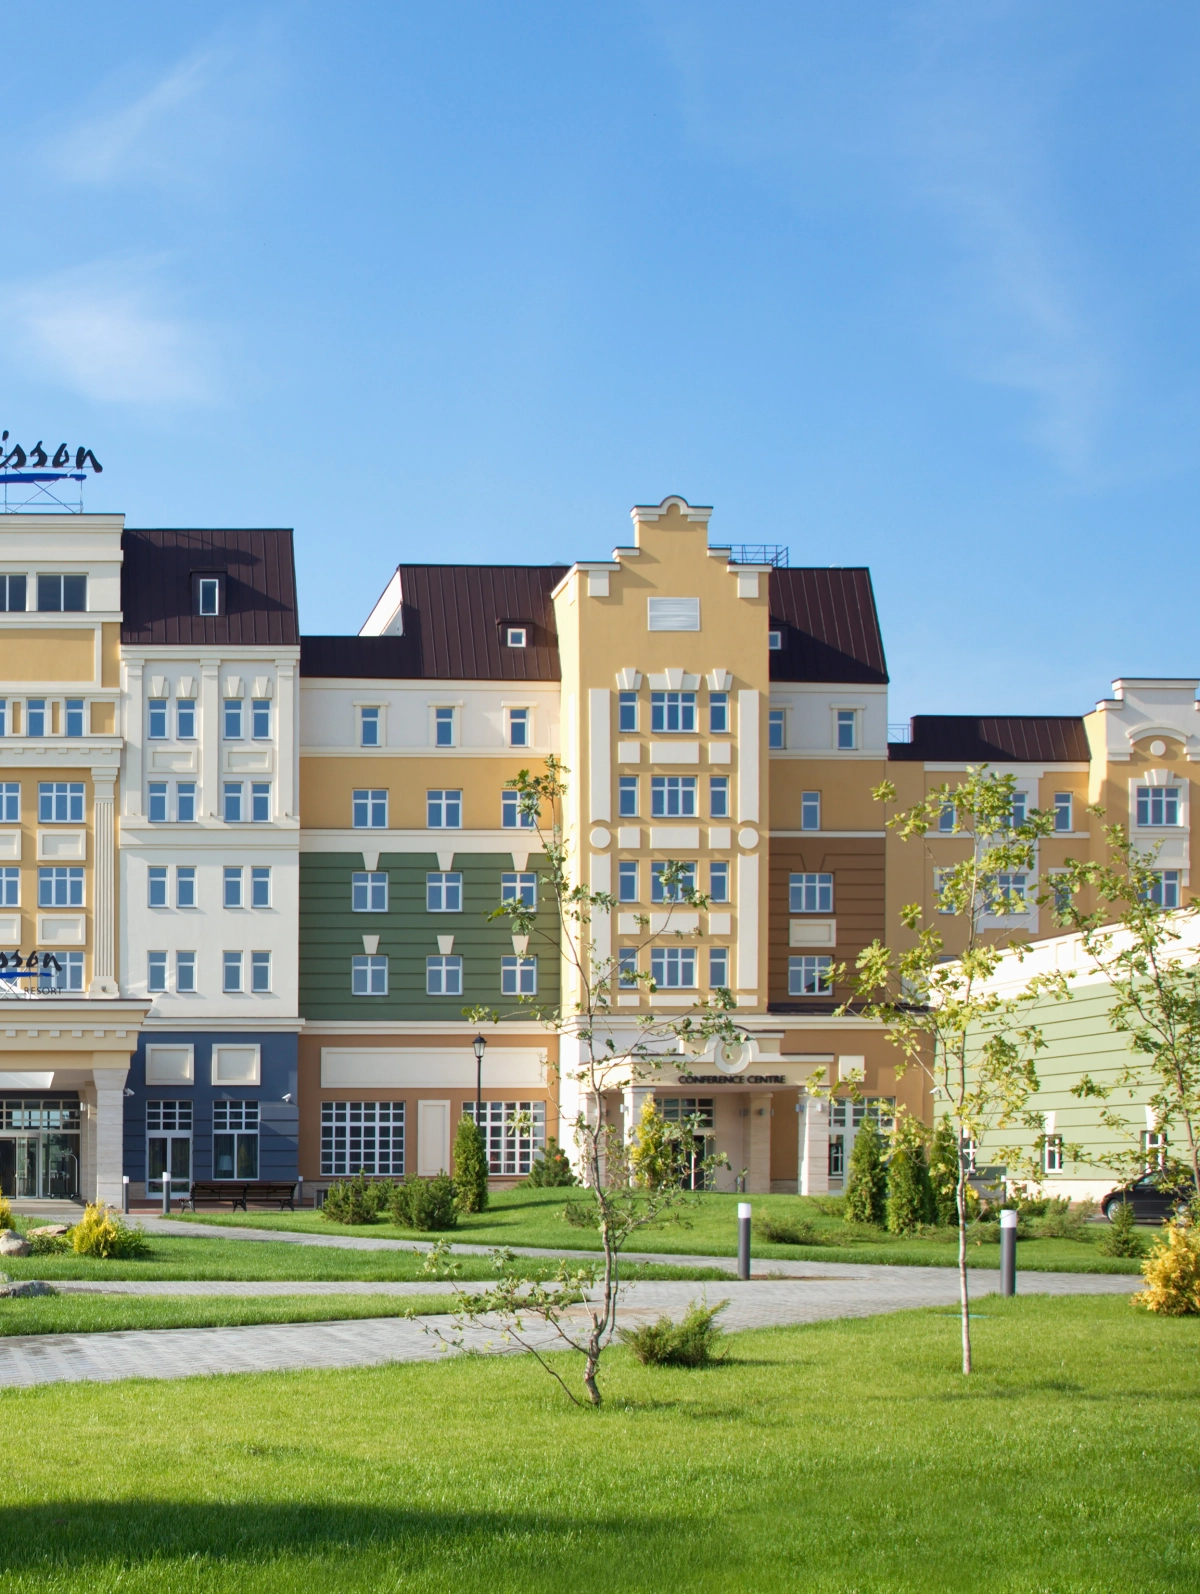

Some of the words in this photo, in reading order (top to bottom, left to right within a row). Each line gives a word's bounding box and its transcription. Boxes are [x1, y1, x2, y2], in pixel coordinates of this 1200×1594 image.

[24, 987, 62, 995] RESORT
[678, 1075, 745, 1084] CONFERENCE
[747, 1075, 786, 1084] CENTRE
